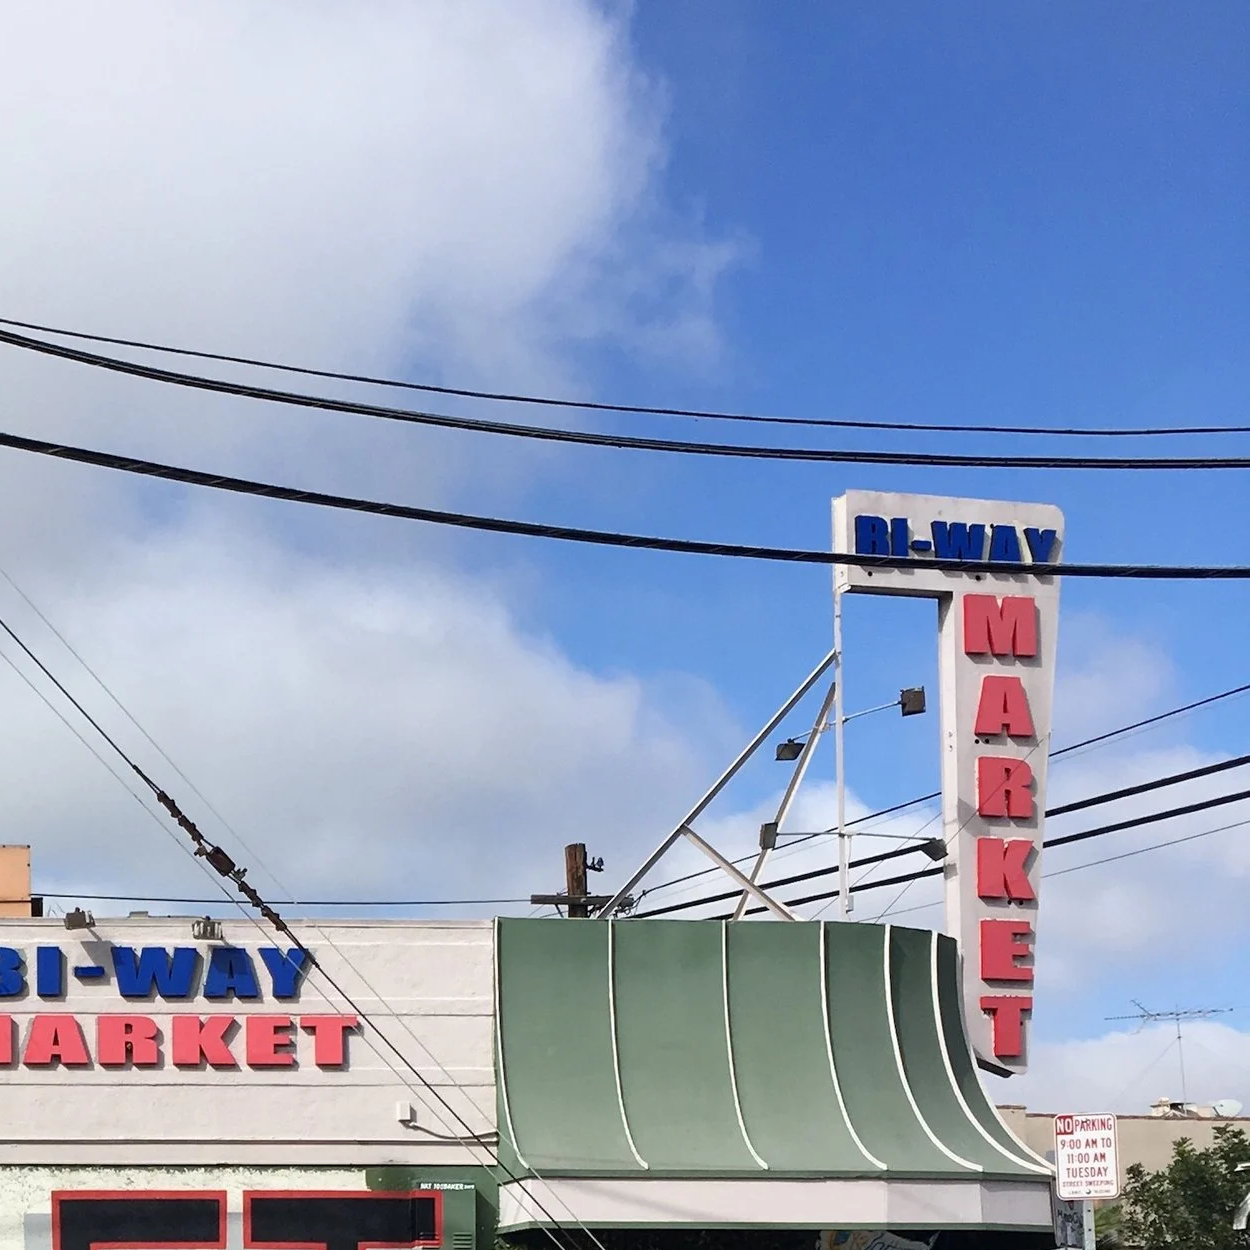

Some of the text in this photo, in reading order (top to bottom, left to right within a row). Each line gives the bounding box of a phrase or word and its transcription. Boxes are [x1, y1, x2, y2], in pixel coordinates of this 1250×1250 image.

[855, 514, 1057, 563] BI-WAY
[963, 592, 1039, 1059] MARKET
[1056, 1117, 1113, 1134] NO PARKING
[1060, 1137, 1112, 1150] 9:00 AM TO
[1067, 1152, 1107, 1164] 11:00 AM
[1066, 1166, 1109, 1178] TUESDAY
